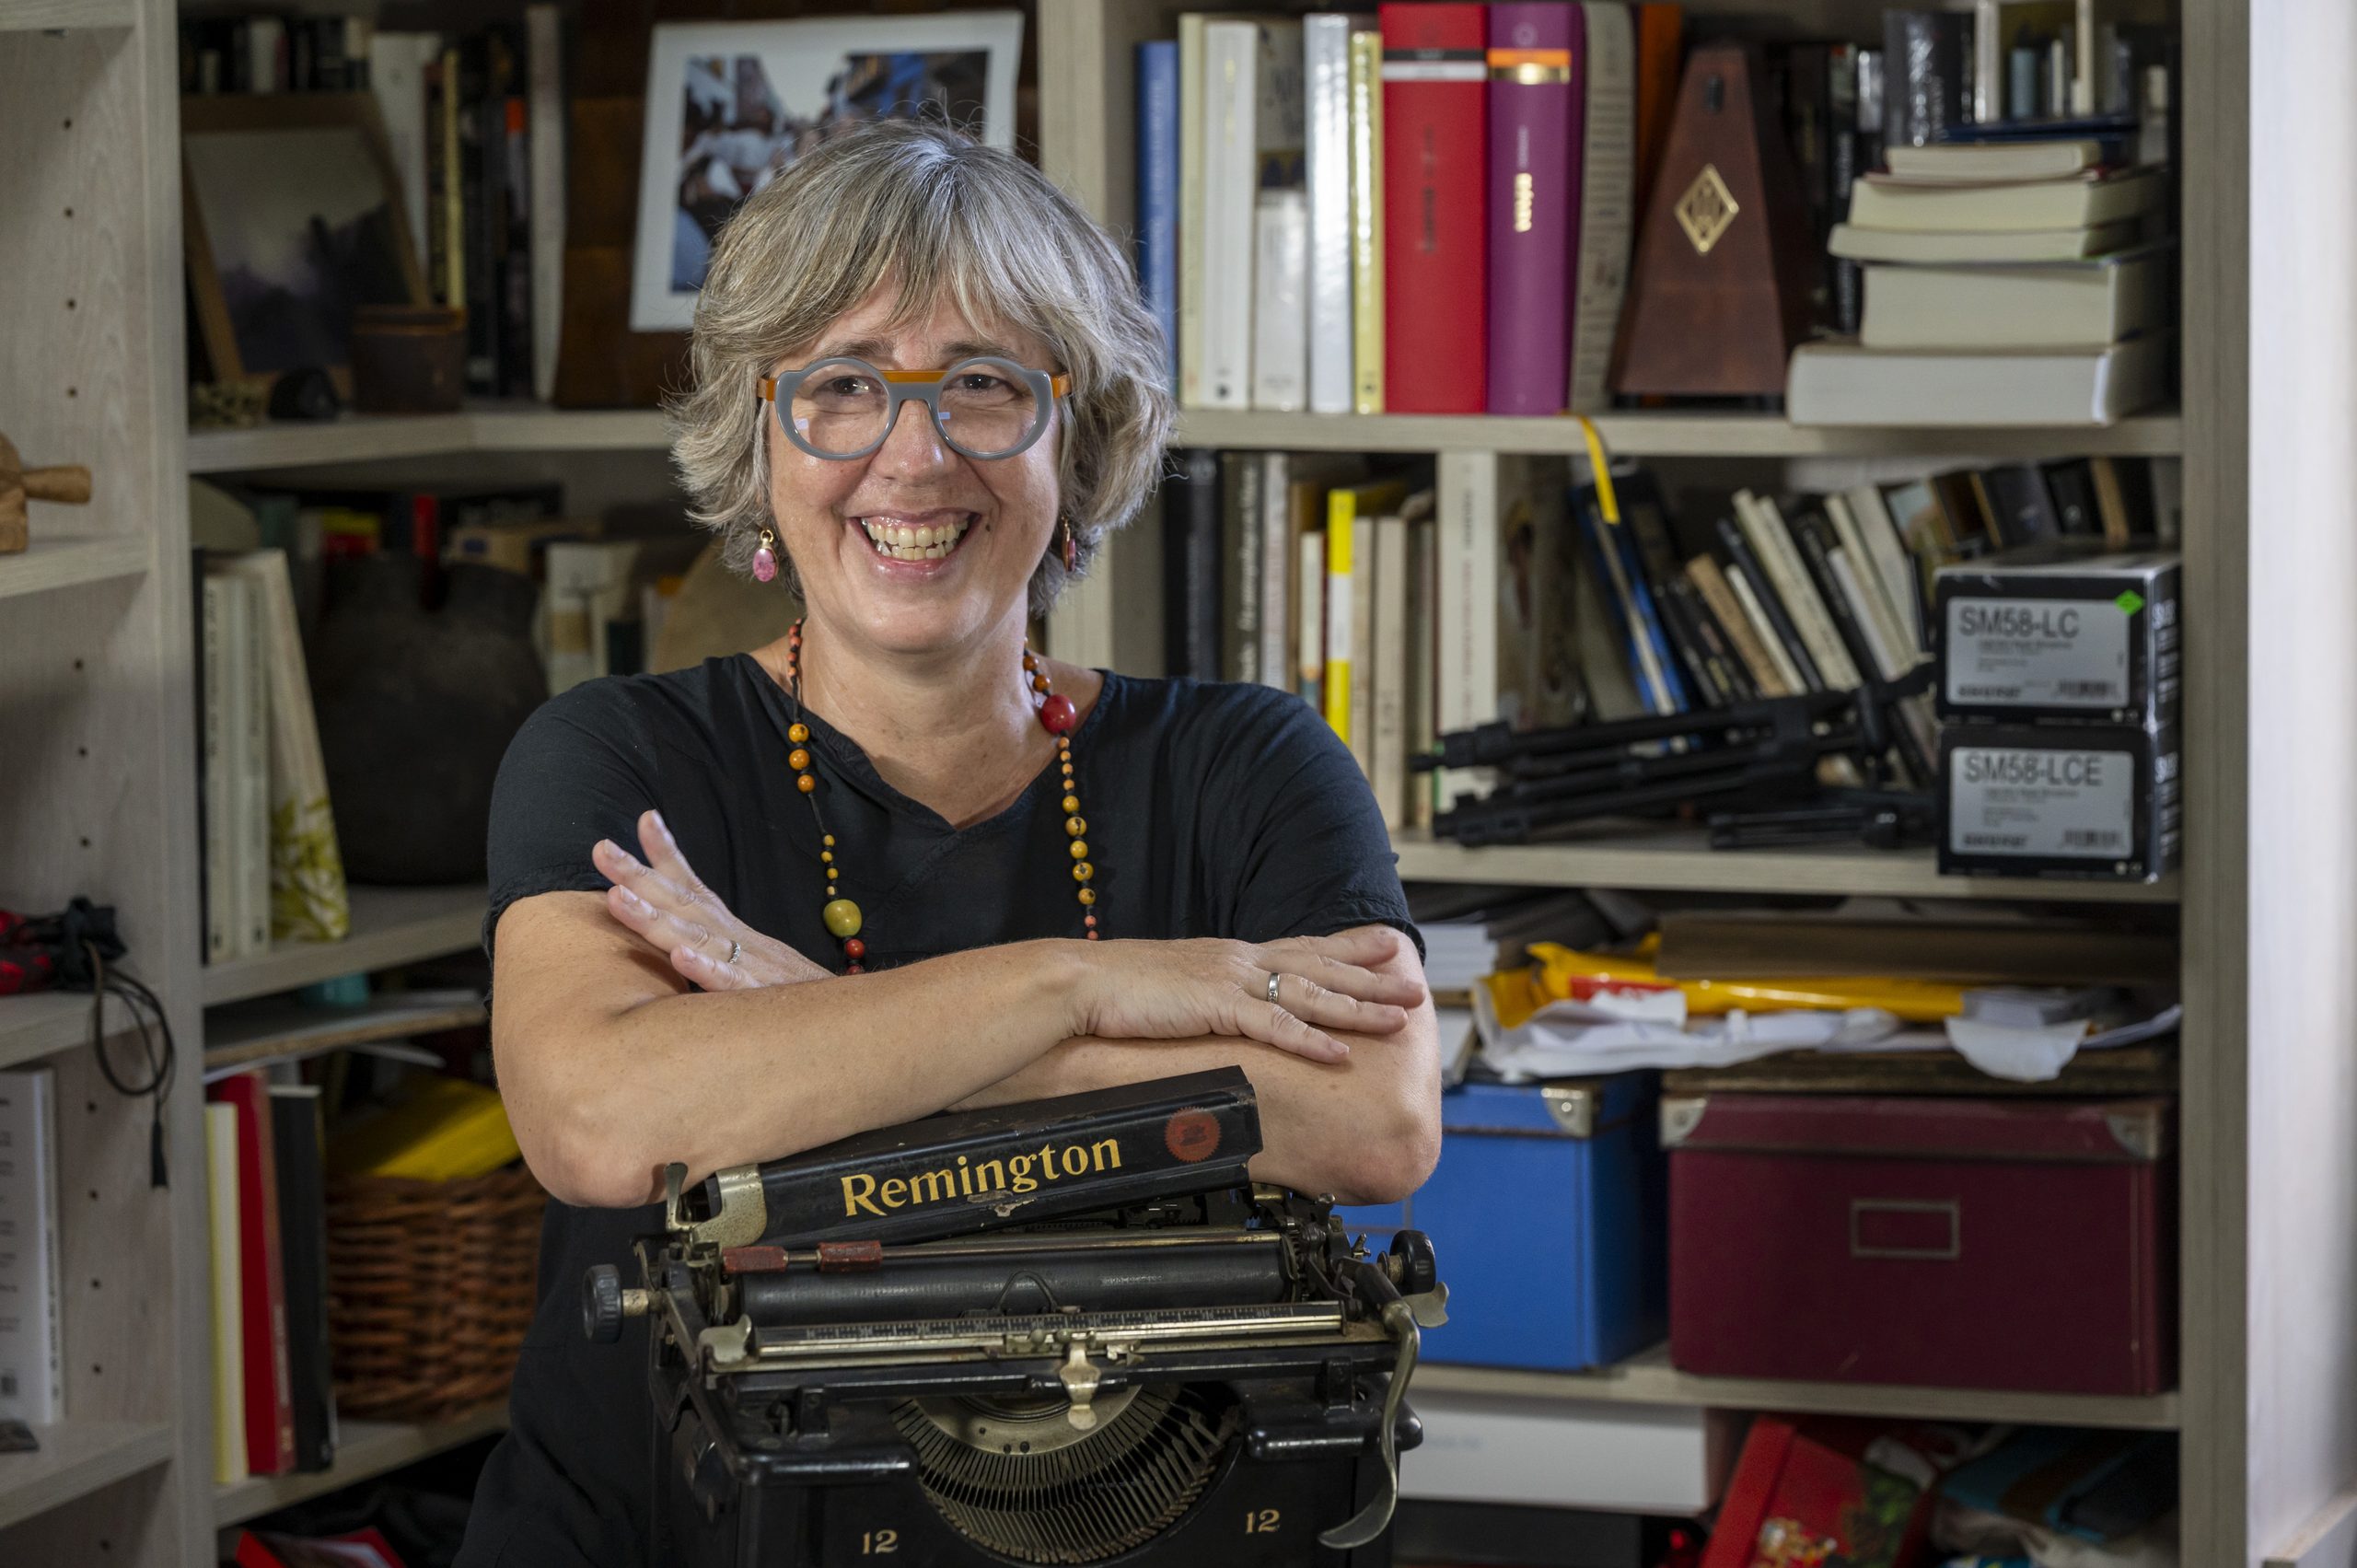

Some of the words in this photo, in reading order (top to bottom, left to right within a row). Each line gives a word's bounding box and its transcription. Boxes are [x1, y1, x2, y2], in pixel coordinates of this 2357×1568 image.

[1958, 606, 2080, 638] SM58-LC
[1964, 752, 2103, 787] SM58-LCE
[840, 1137, 1122, 1217] Remington
[1245, 1509, 1282, 1535] 12
[862, 1528, 900, 1556] 12
